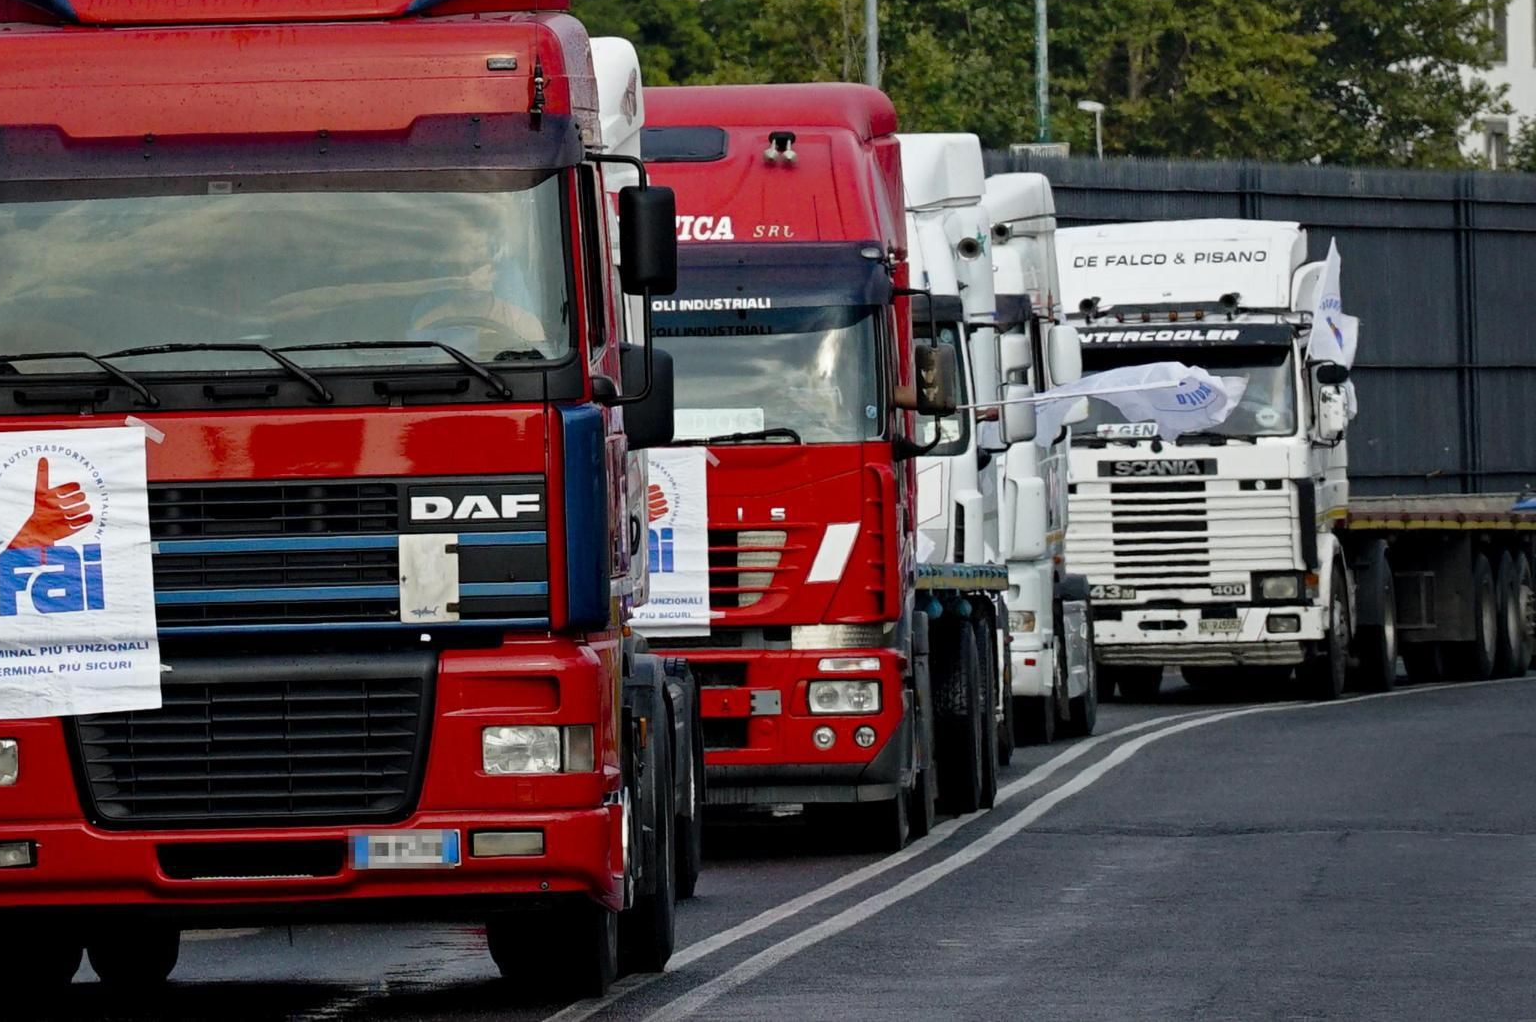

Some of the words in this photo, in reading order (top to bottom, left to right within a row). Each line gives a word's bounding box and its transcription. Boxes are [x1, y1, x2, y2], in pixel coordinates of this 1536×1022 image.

[675, 215, 734, 240] ICA
[753, 225, 795, 237] SRL
[1073, 256, 1098, 268] DE
[1105, 253, 1167, 266] FALCO
[1173, 252, 1186, 264] &
[1194, 250, 1267, 264] PISANO
[652, 300, 675, 311] OLI
[679, 297, 771, 310] INDUSTRIALI
[1079, 329, 1240, 343] NTERCOOLER
[1115, 460, 1201, 476] SCANIA
[3, 444, 106, 490] AUTOTRASPORTATORI
[93, 492, 110, 540] ITALIANI
[410, 494, 540, 520] DAF
[1214, 585, 1245, 596] 400
[651, 596, 703, 606] UNZIONALI
[67, 641, 149, 653] FUNZIONALI
[86, 660, 132, 670] SICURI
